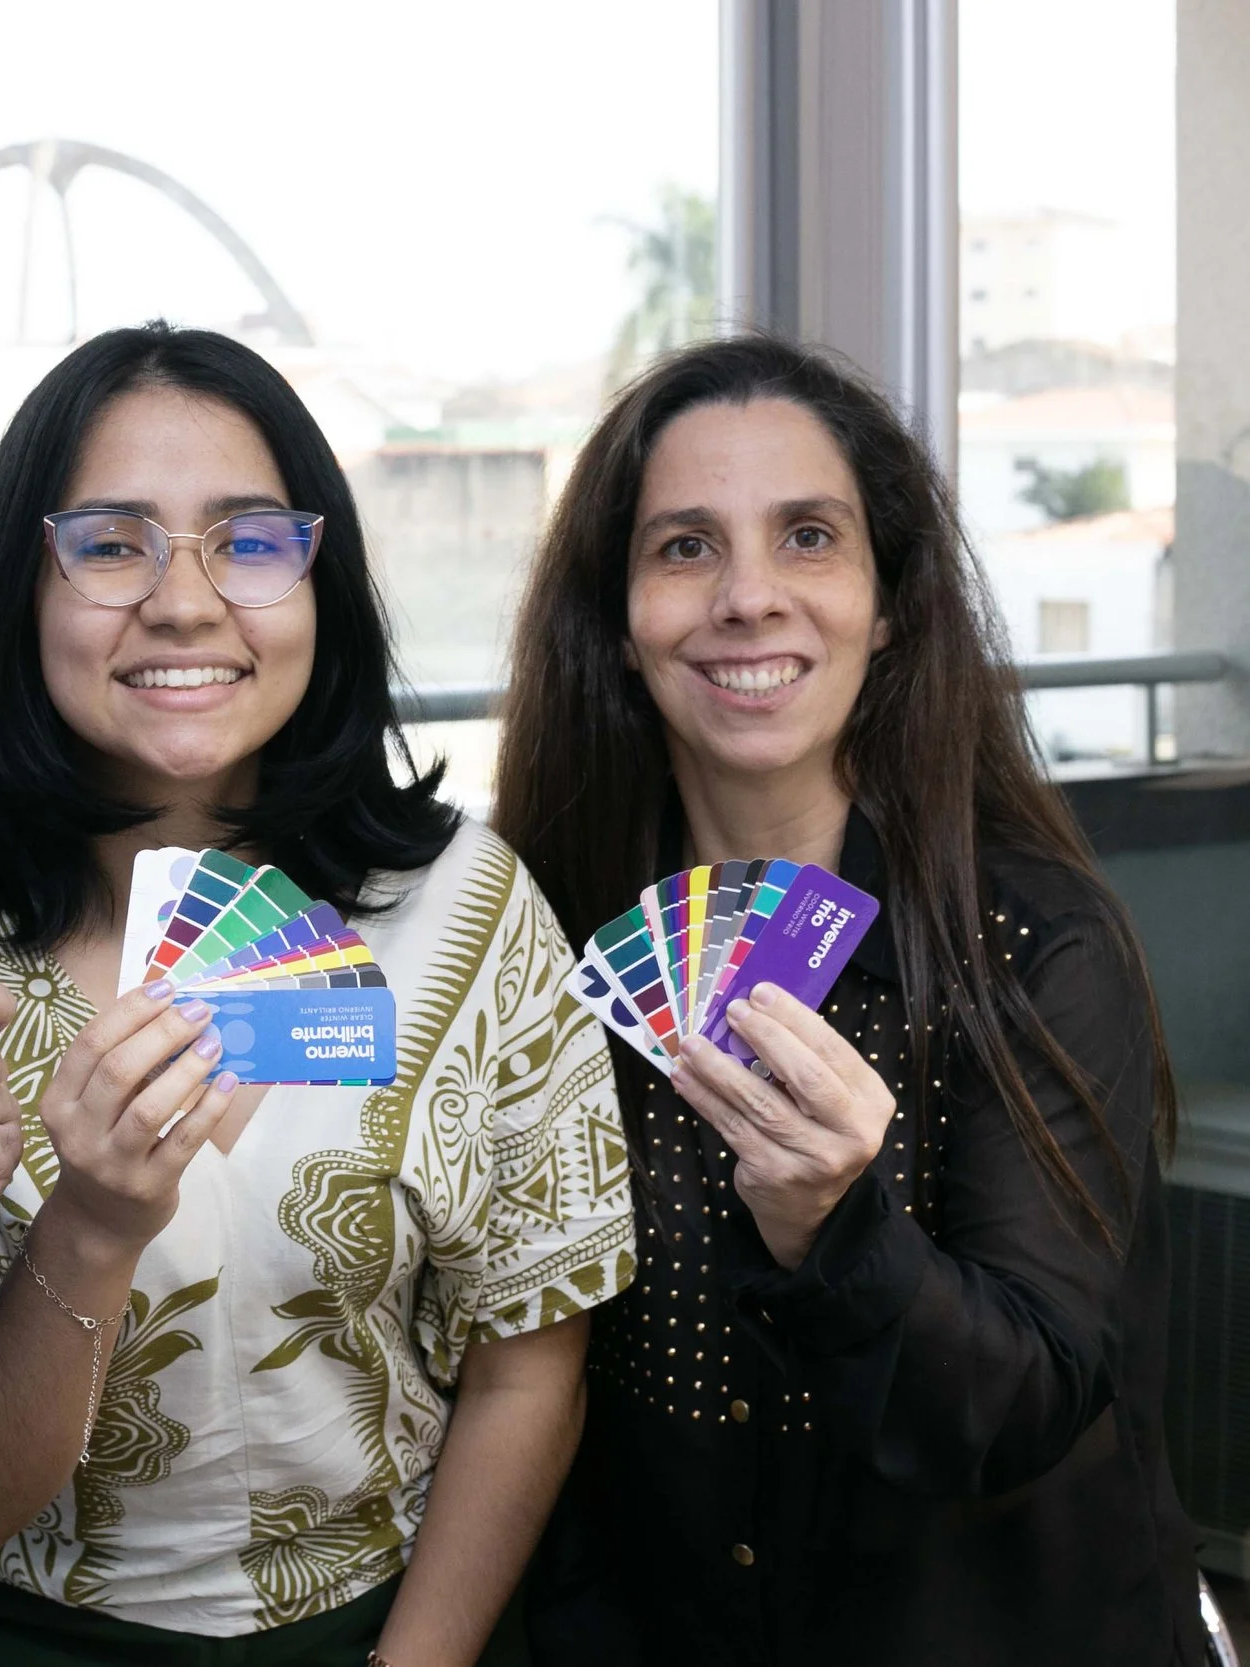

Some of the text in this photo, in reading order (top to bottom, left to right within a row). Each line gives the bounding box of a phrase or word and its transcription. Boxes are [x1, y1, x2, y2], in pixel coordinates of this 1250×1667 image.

[783, 889, 814, 935] INVIERNO FRIO
[791, 893, 820, 938] COOL WINTER
[811, 899, 837, 927] frio
[808, 907, 856, 969] inverno
[291, 1025, 374, 1043] brilhante
[305, 1044, 375, 1062] inverno
